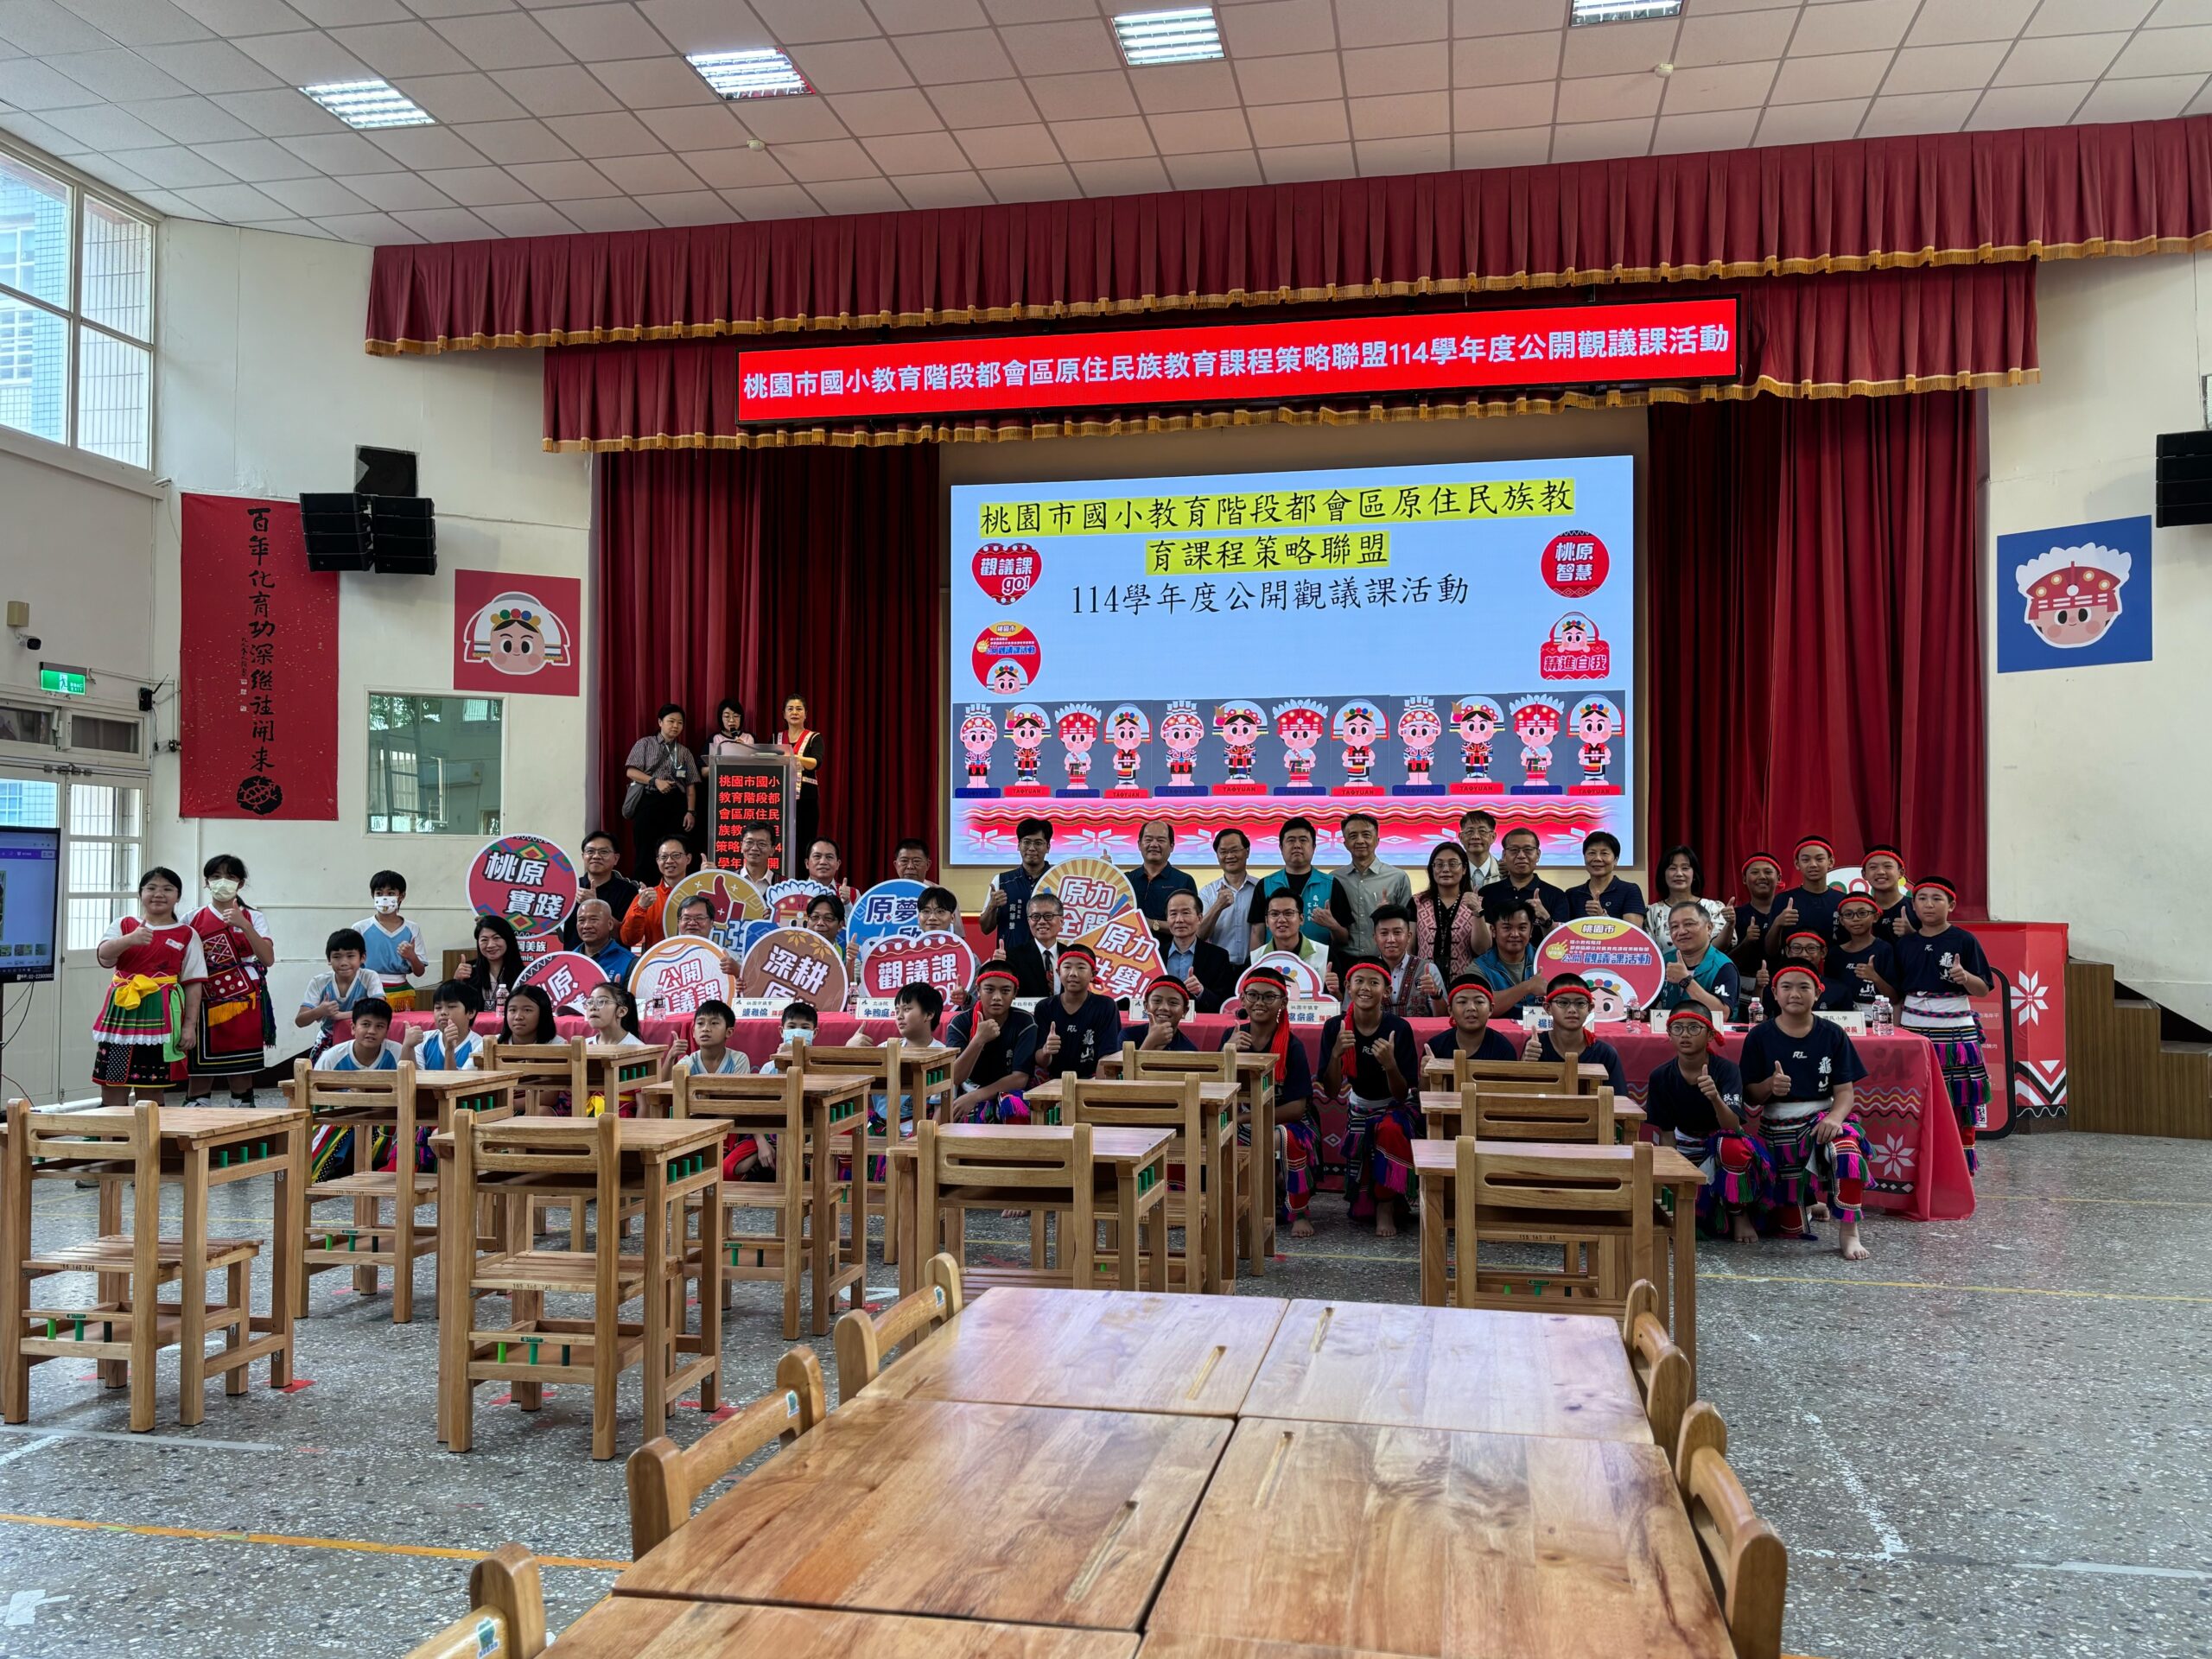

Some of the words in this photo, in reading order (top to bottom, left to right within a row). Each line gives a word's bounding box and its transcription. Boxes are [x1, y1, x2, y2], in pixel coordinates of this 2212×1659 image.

[744, 324, 1728, 398] 桃園市國小教育階段都會區原住民族教育課程策略聯盟114學年度公開觀議課活動
[981, 480, 1573, 534] 桃園市國小教育階段都會區原住民族教
[1149, 533, 1388, 572] 育課程策略聯盟
[1555, 543, 1594, 561] 桃原
[980, 557, 1033, 575] 觀議課
[1556, 563, 1592, 582] 智慧
[1002, 576, 1030, 595] go!
[1072, 574, 1468, 615] 114學年度公開觀議課活動
[1543, 655, 1606, 671] 精進自我
[719, 775, 780, 787] 桃園市國小
[719, 791, 780, 804] 教育階段都
[719, 808, 780, 820] 會區原住民
[484, 852, 548, 886] 桃原
[718, 858, 779, 869] 學年開
[505, 890, 564, 920] 實踐
[1059, 877, 1116, 910] 原力
[1582, 925, 1615, 933] 桃園市
[1096, 922, 1156, 963] 原力
[762, 945, 830, 995] 深耕
[1584, 952, 1652, 965] 觀議課活動
[658, 959, 702, 993] 公開
[878, 953, 957, 990] 觀議課
